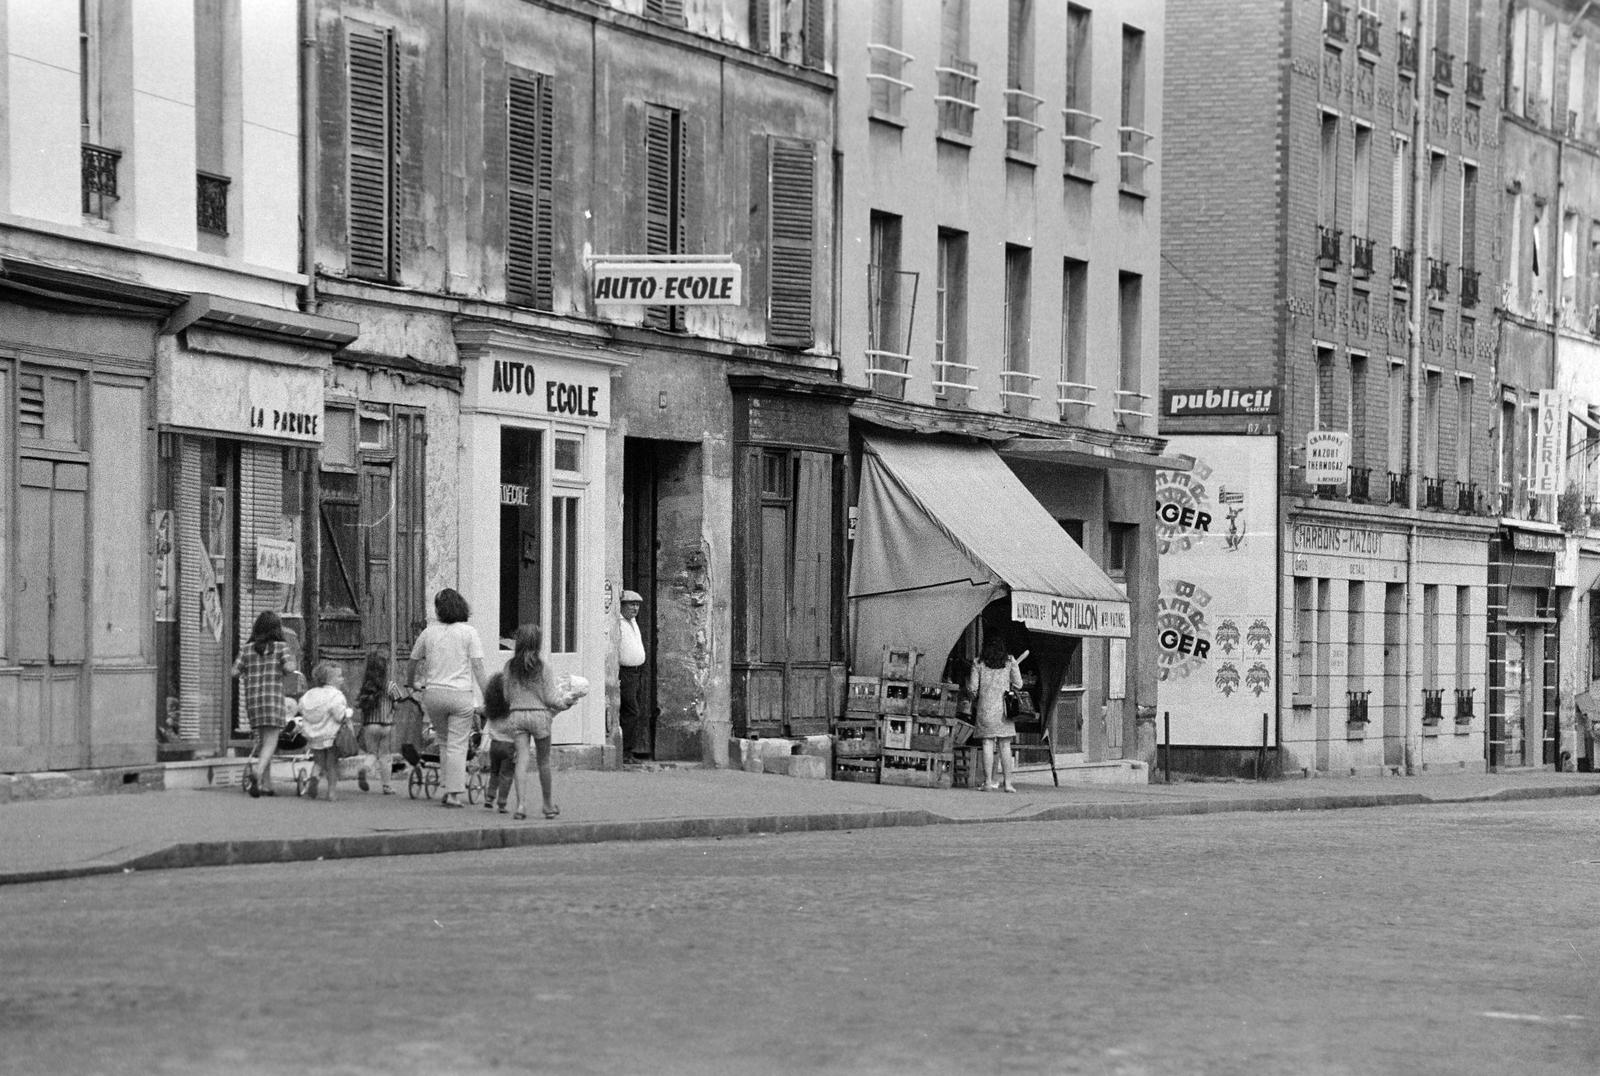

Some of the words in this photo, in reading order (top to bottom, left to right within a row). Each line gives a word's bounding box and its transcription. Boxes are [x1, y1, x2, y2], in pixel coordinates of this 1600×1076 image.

[492, 359, 536, 396] AUTO
[546, 380, 599, 417] ECOLE
[1170, 389, 1272, 414] publicit
[250, 406, 264, 428] LA
[273, 409, 318, 435] PARURE
[1310, 434, 1343, 446] CHARBONS
[1312, 448, 1339, 458] MAZOUT
[1540, 393, 1555, 491] LAVERIE
[1308, 460, 1343, 470] THERMOGAZ
[1294, 525, 1341, 551] CHARBONS
[1537, 536, 1562, 550] BLANC
[1051, 600, 1098, 630] POSTILLON
[1158, 630, 1211, 659] GER
